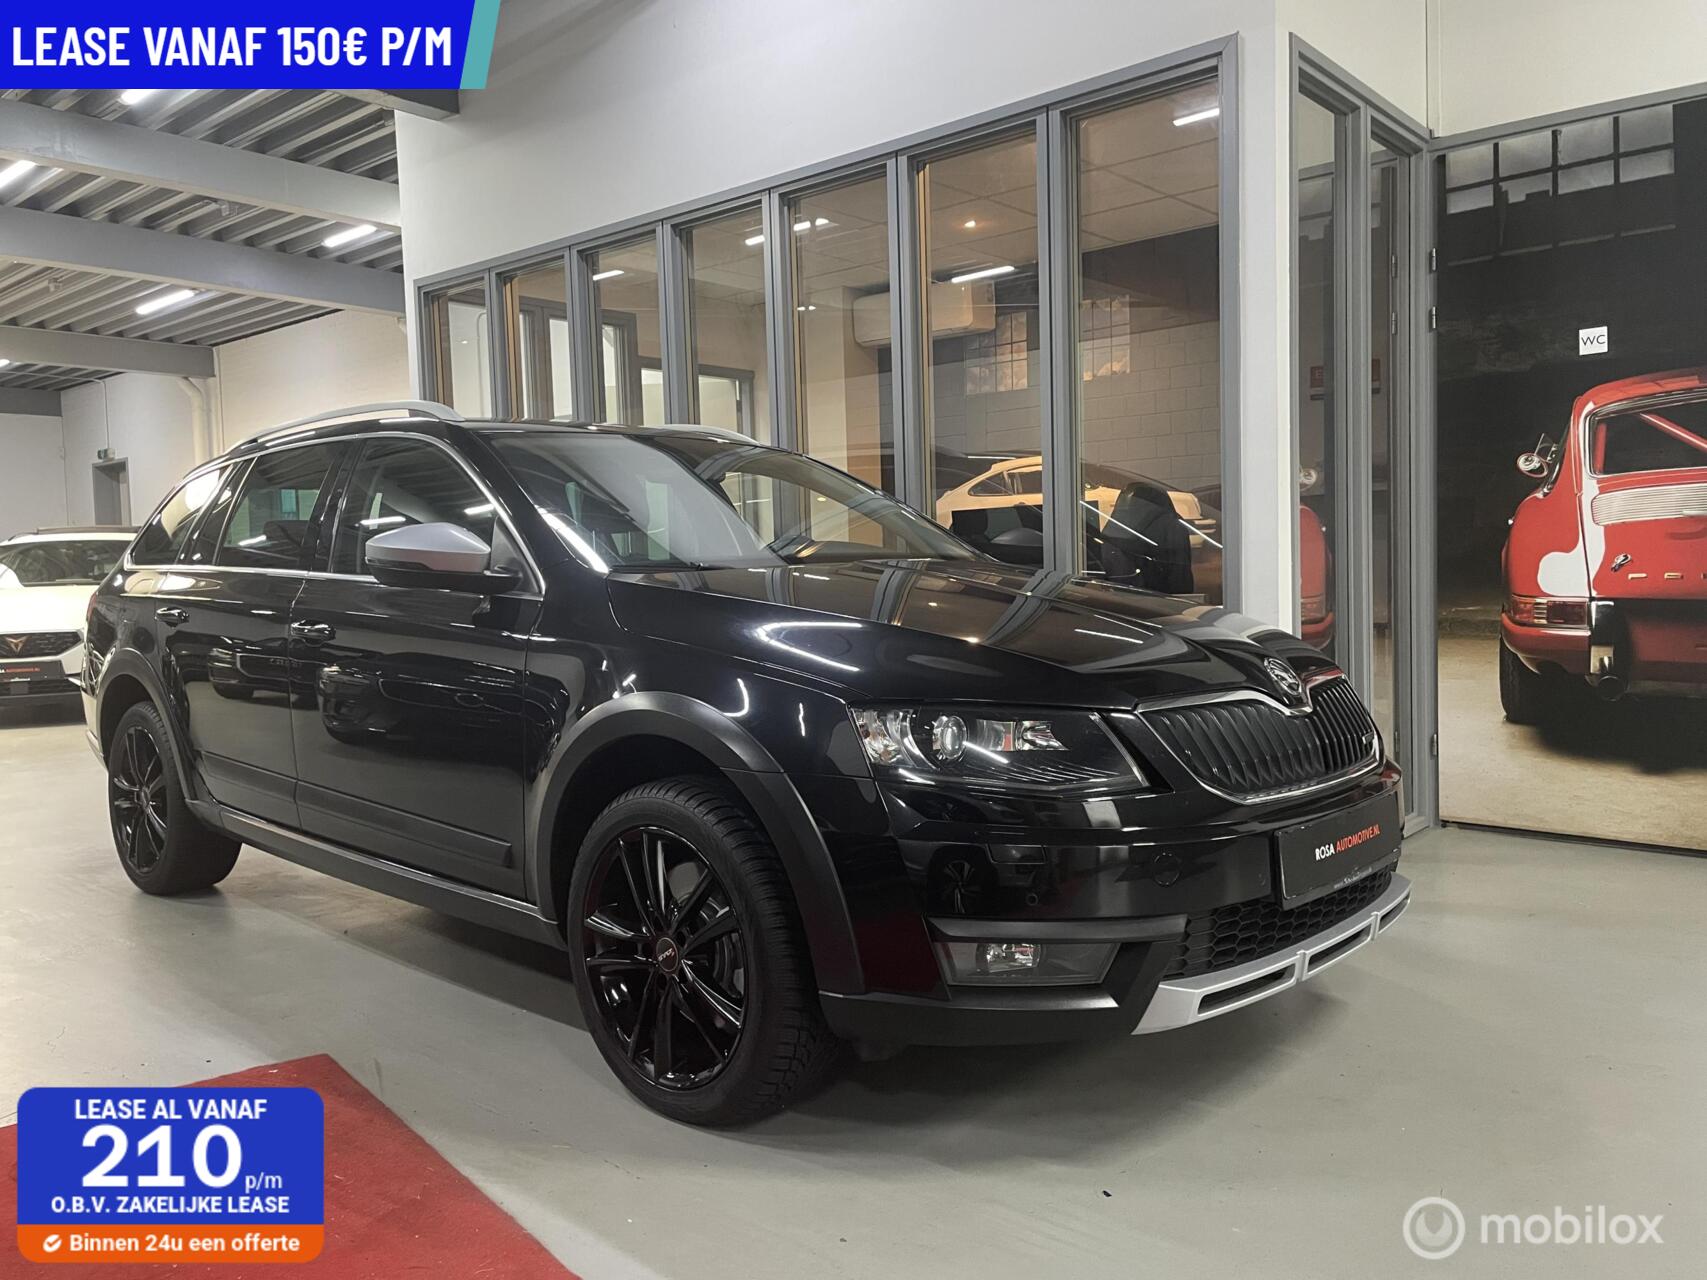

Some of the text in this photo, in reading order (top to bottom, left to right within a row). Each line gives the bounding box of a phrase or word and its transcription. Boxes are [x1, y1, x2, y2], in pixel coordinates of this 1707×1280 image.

[1581, 334, 1606, 346] WC
[1315, 824, 1380, 861] ROSA AUTOMOTIVE.NL
